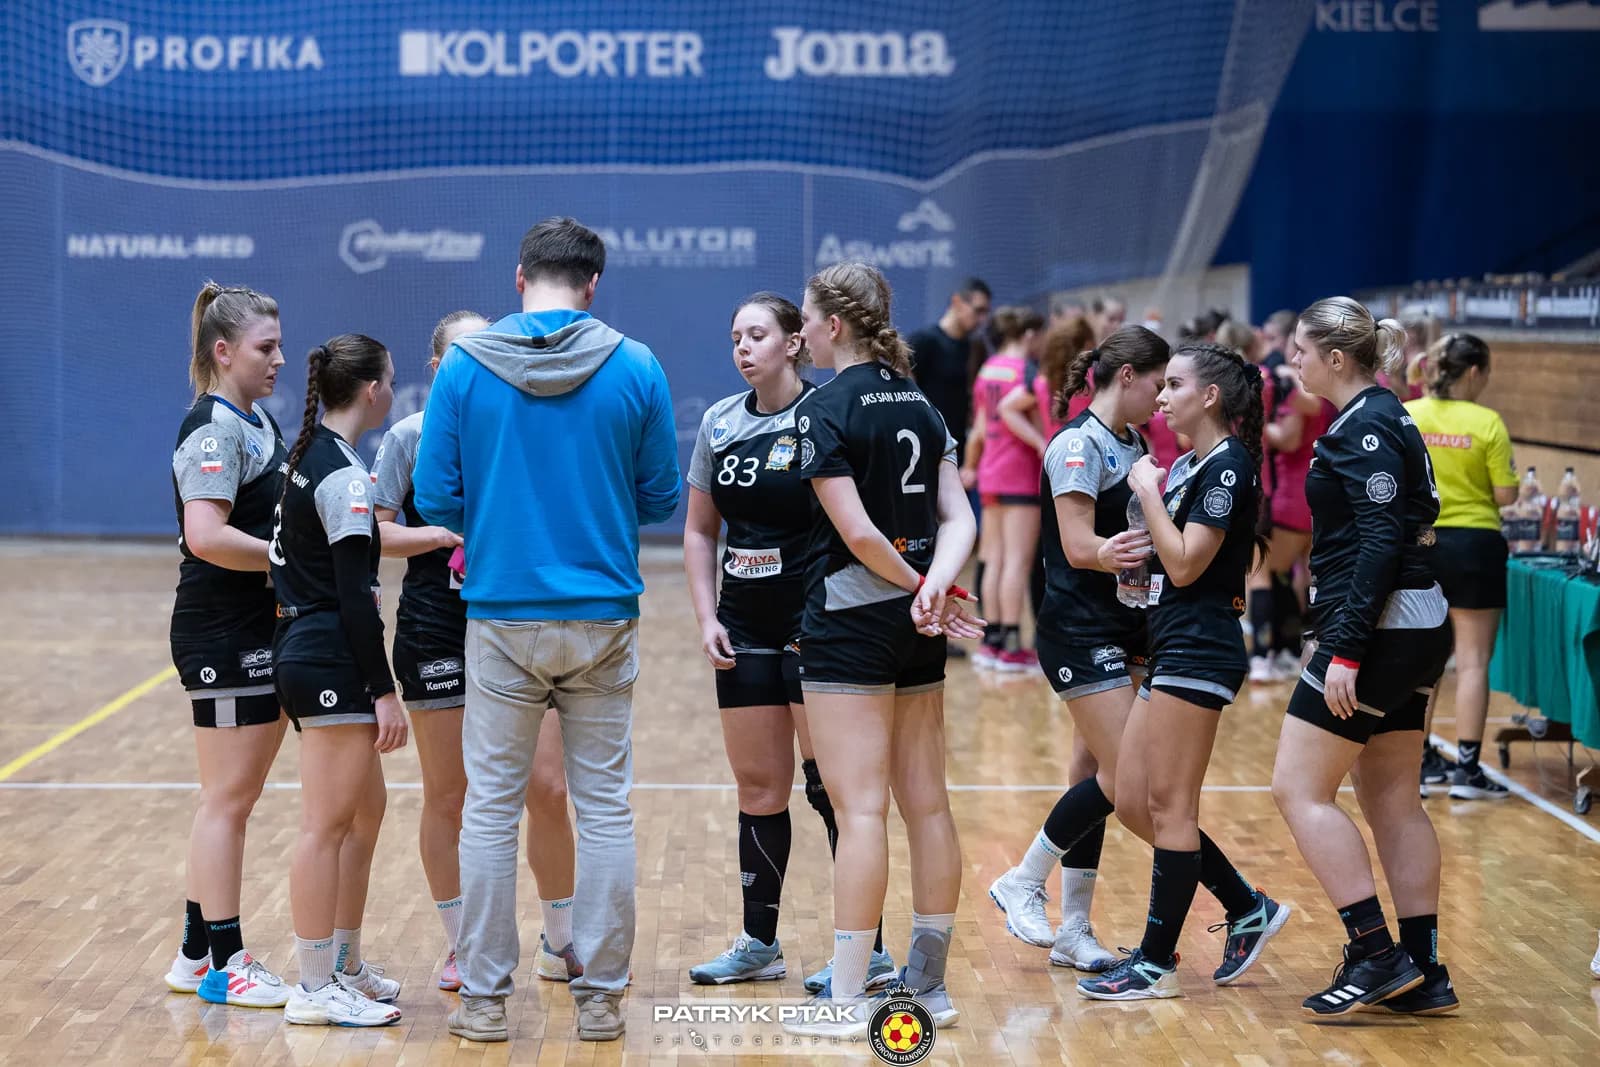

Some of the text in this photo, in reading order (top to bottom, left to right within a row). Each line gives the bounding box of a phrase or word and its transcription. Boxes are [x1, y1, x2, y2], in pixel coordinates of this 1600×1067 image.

[1315, 1, 1439, 32] KIELCE
[134, 36, 324, 71] PROFIKA
[430, 30, 704, 77] KOLPORTER
[765, 27, 956, 80] Joma
[67, 234, 255, 259] NATURAL-MED
[595, 227, 757, 251] ALUTOR
[860, 393, 877, 406] JKS
[875, 391, 894, 403] SAN
[717, 455, 760, 487] 83
[896, 428, 926, 494] 2
[248, 667, 273, 679] Kemp
[425, 679, 460, 691] Kempa
